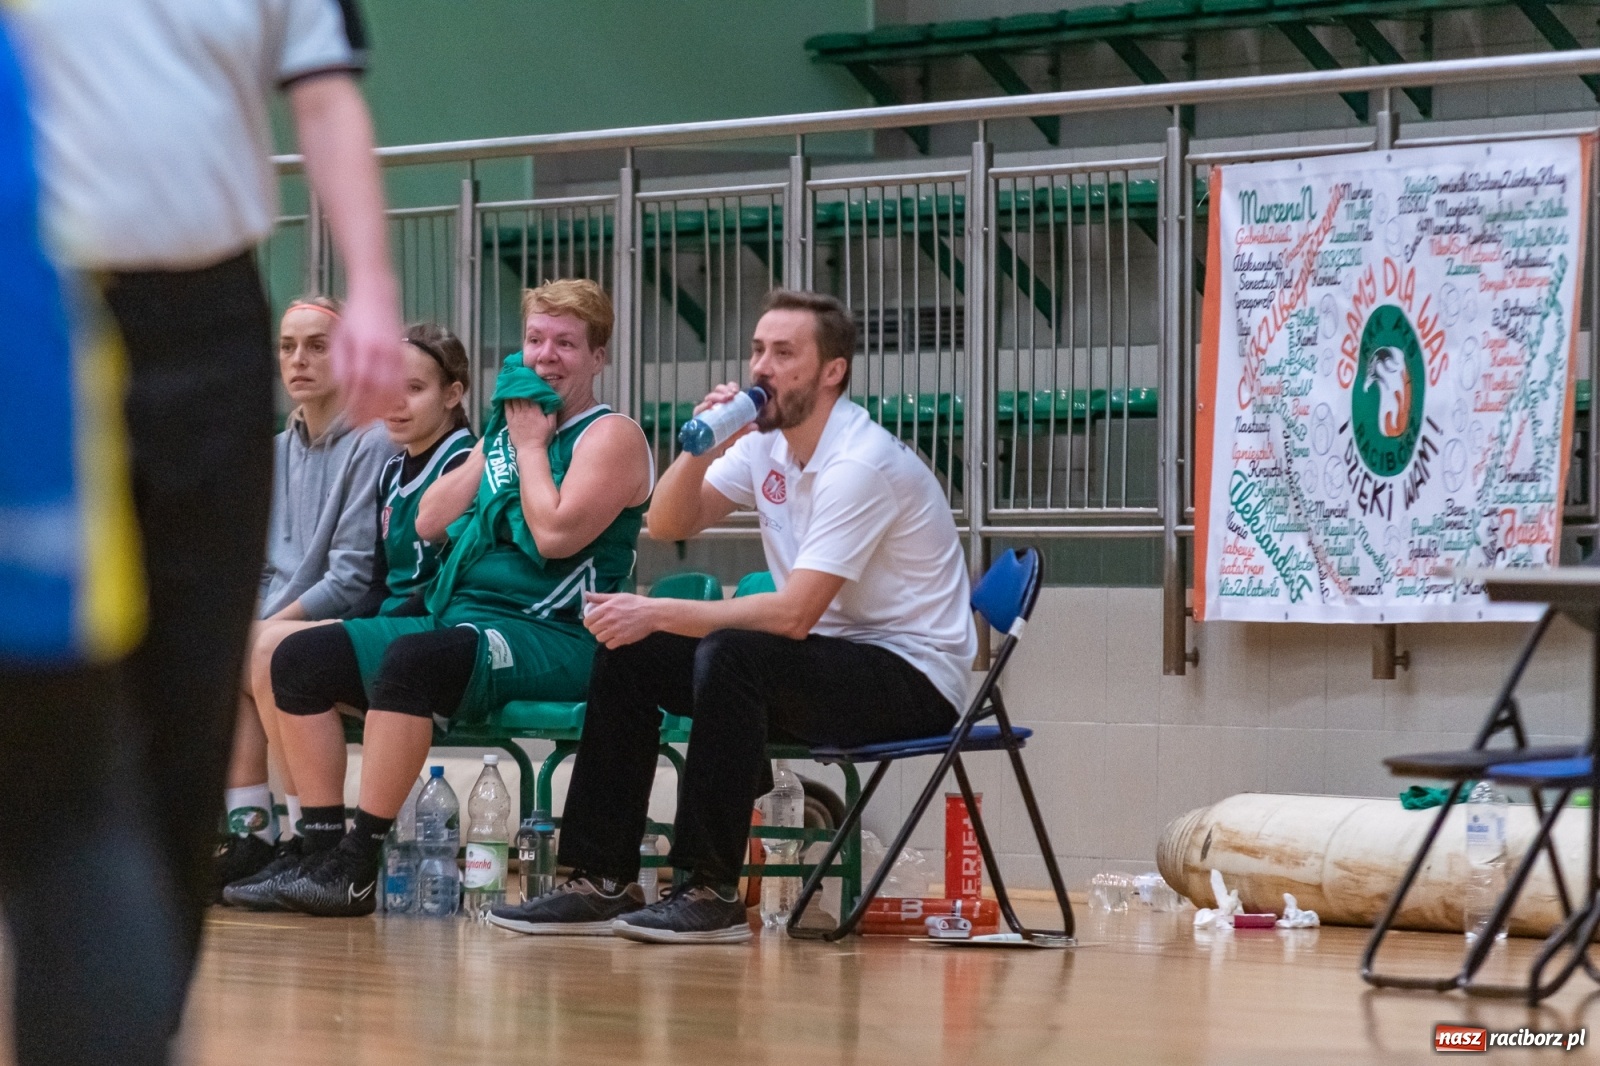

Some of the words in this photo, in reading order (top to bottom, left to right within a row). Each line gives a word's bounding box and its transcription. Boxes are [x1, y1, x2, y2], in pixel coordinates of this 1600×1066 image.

[1337, 263, 1376, 389] GRAMY
[1383, 256, 1415, 312] DLA
[1417, 293, 1449, 387] WAS
[305, 822, 342, 831] adidas
